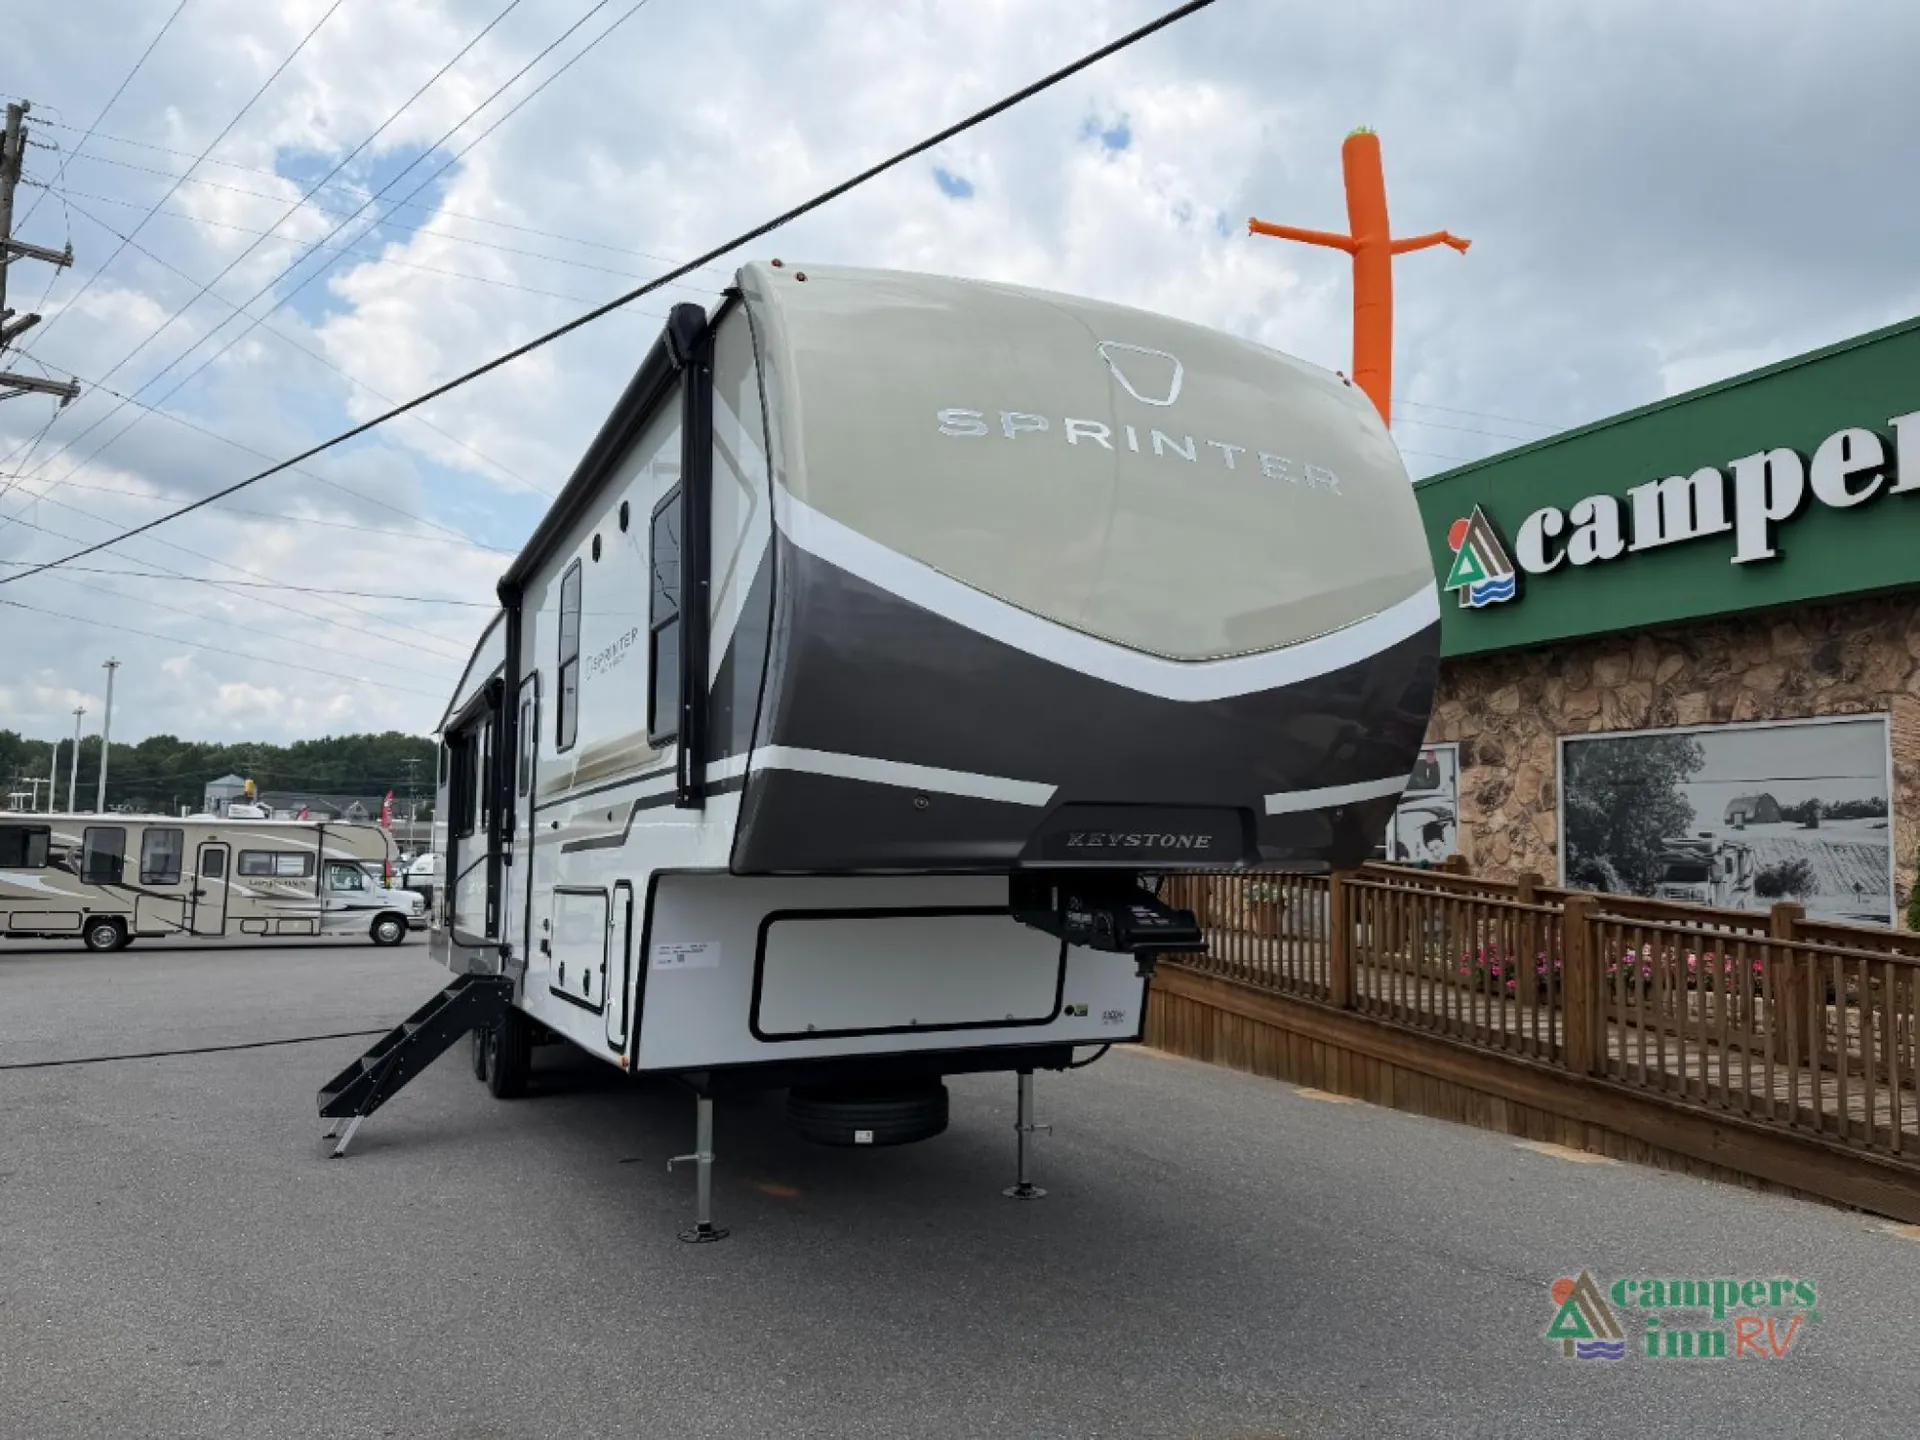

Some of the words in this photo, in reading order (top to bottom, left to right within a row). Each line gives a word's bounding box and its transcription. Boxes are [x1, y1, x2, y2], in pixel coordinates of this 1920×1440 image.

[937, 408, 1343, 496] SPRINTER
[591, 627, 638, 671] SPRINTER
[1066, 832, 1213, 849] KEYSTONE
